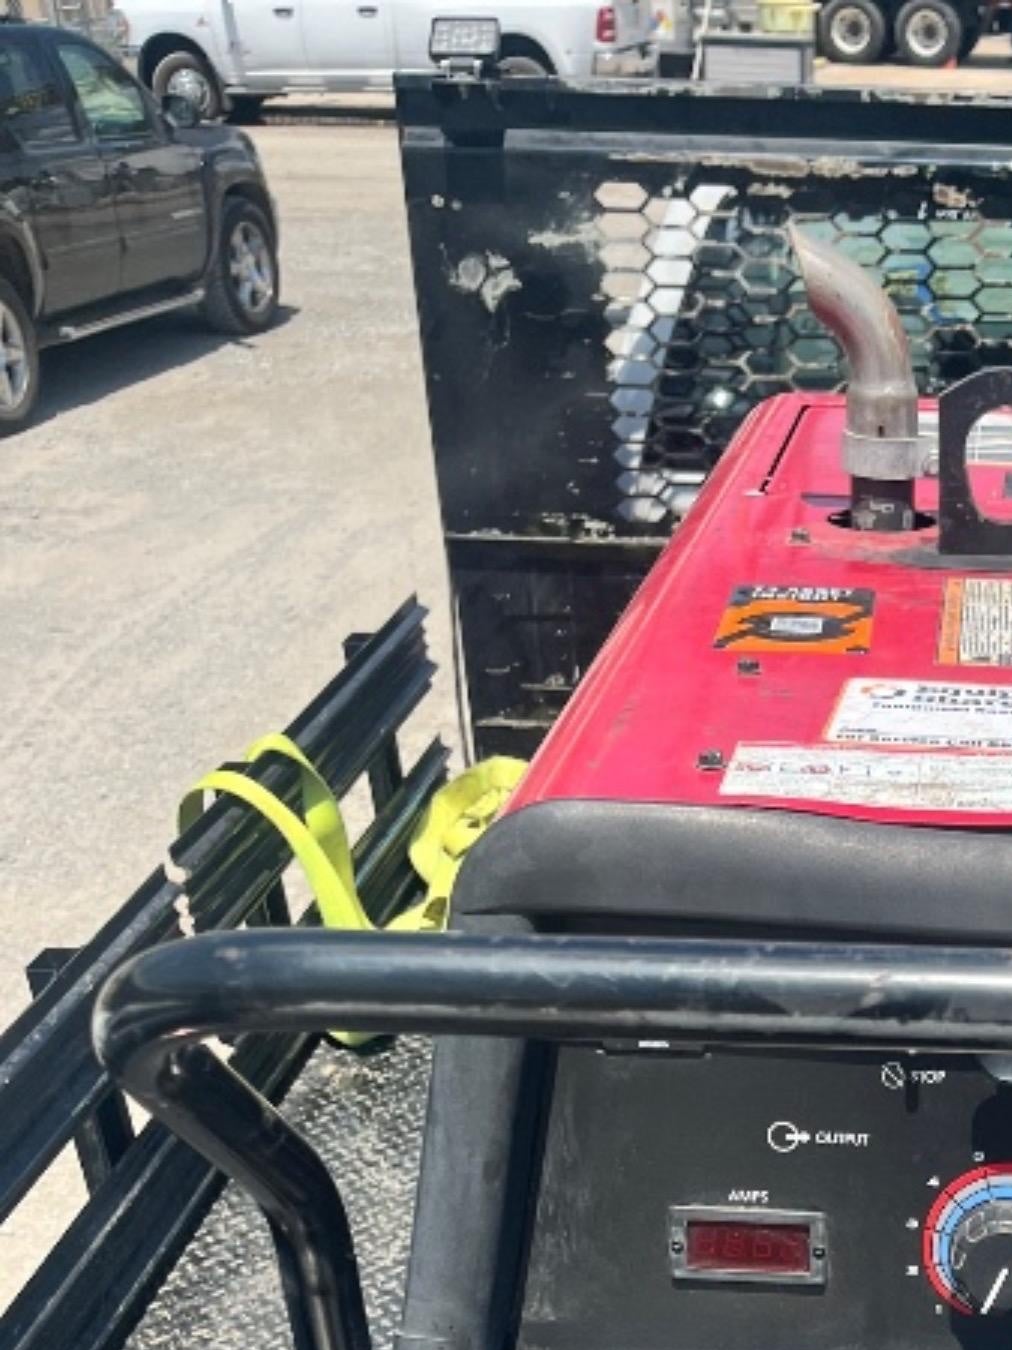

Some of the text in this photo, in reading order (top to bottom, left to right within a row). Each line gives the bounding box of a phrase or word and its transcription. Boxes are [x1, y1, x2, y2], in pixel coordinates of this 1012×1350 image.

[911, 1070, 946, 1084] STOP
[815, 1130, 870, 1146] OUTPUT
[728, 1190, 769, 1203] AMPS
